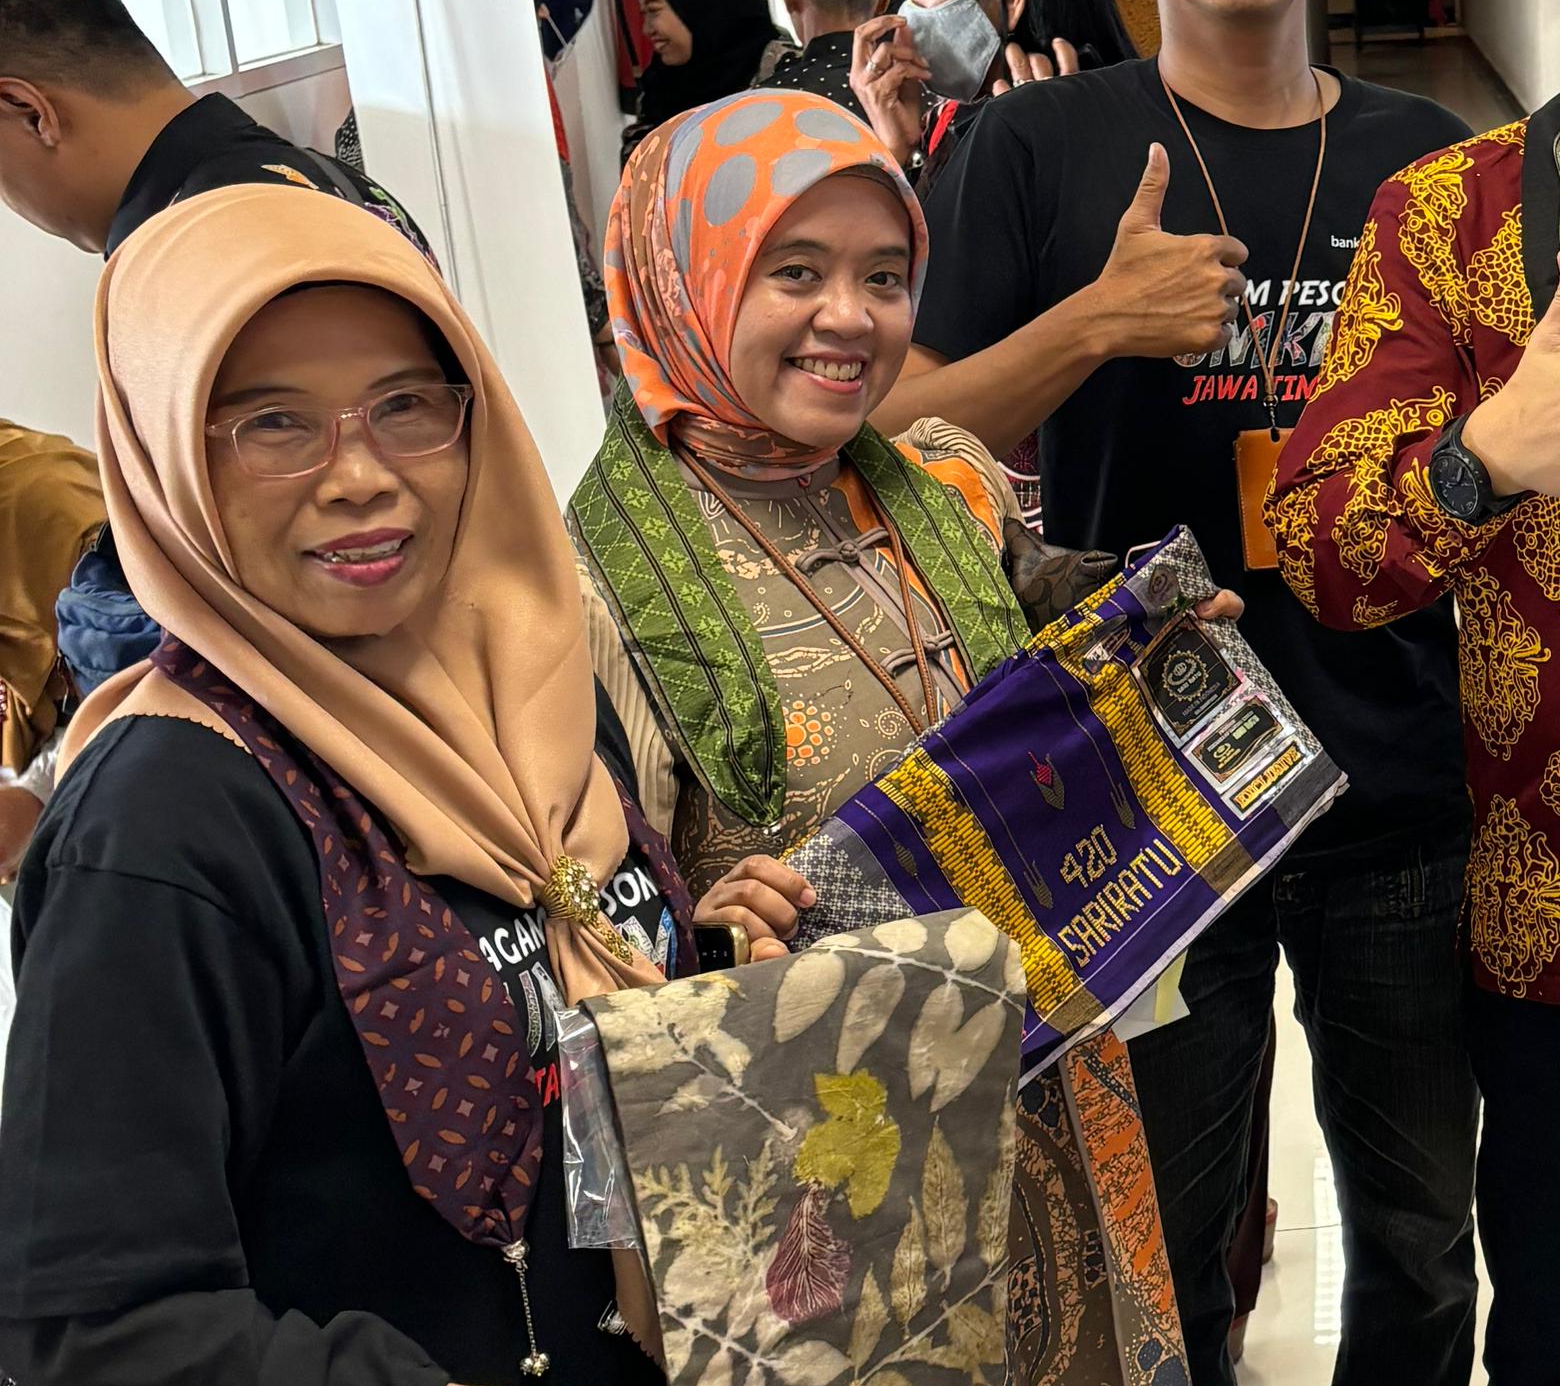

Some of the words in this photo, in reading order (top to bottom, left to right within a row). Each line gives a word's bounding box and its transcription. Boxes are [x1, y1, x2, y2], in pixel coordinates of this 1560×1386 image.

[1279, 279, 1347, 306] PESO
[1182, 374, 1258, 405] JAWA
[1233, 744, 1302, 809] EXCLUSIVE
[1059, 823, 1119, 888] 420
